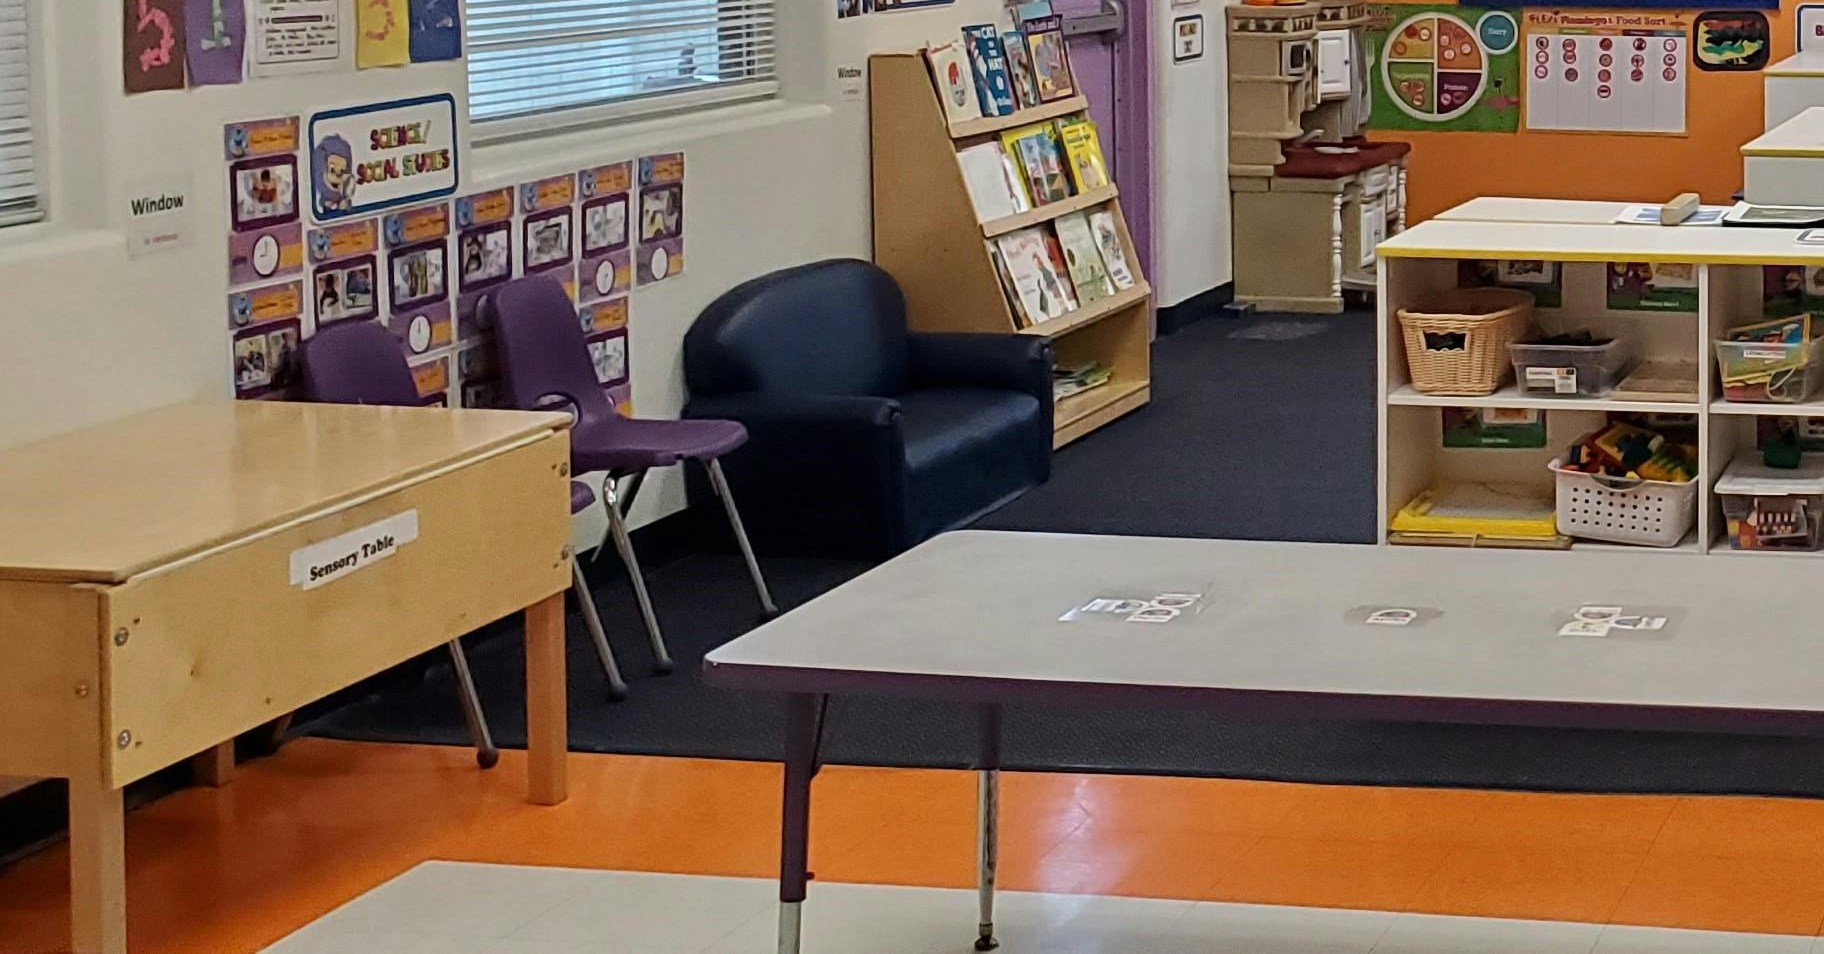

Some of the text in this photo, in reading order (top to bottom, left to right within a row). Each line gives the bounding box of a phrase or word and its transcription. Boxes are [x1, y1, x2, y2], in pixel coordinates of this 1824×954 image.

[1616, 16, 1641, 25] Food
[838, 67, 861, 78] Window
[357, 157, 399, 185] SOCIAL
[131, 193, 184, 216] Window
[310, 535, 395, 581] Sensory Table
